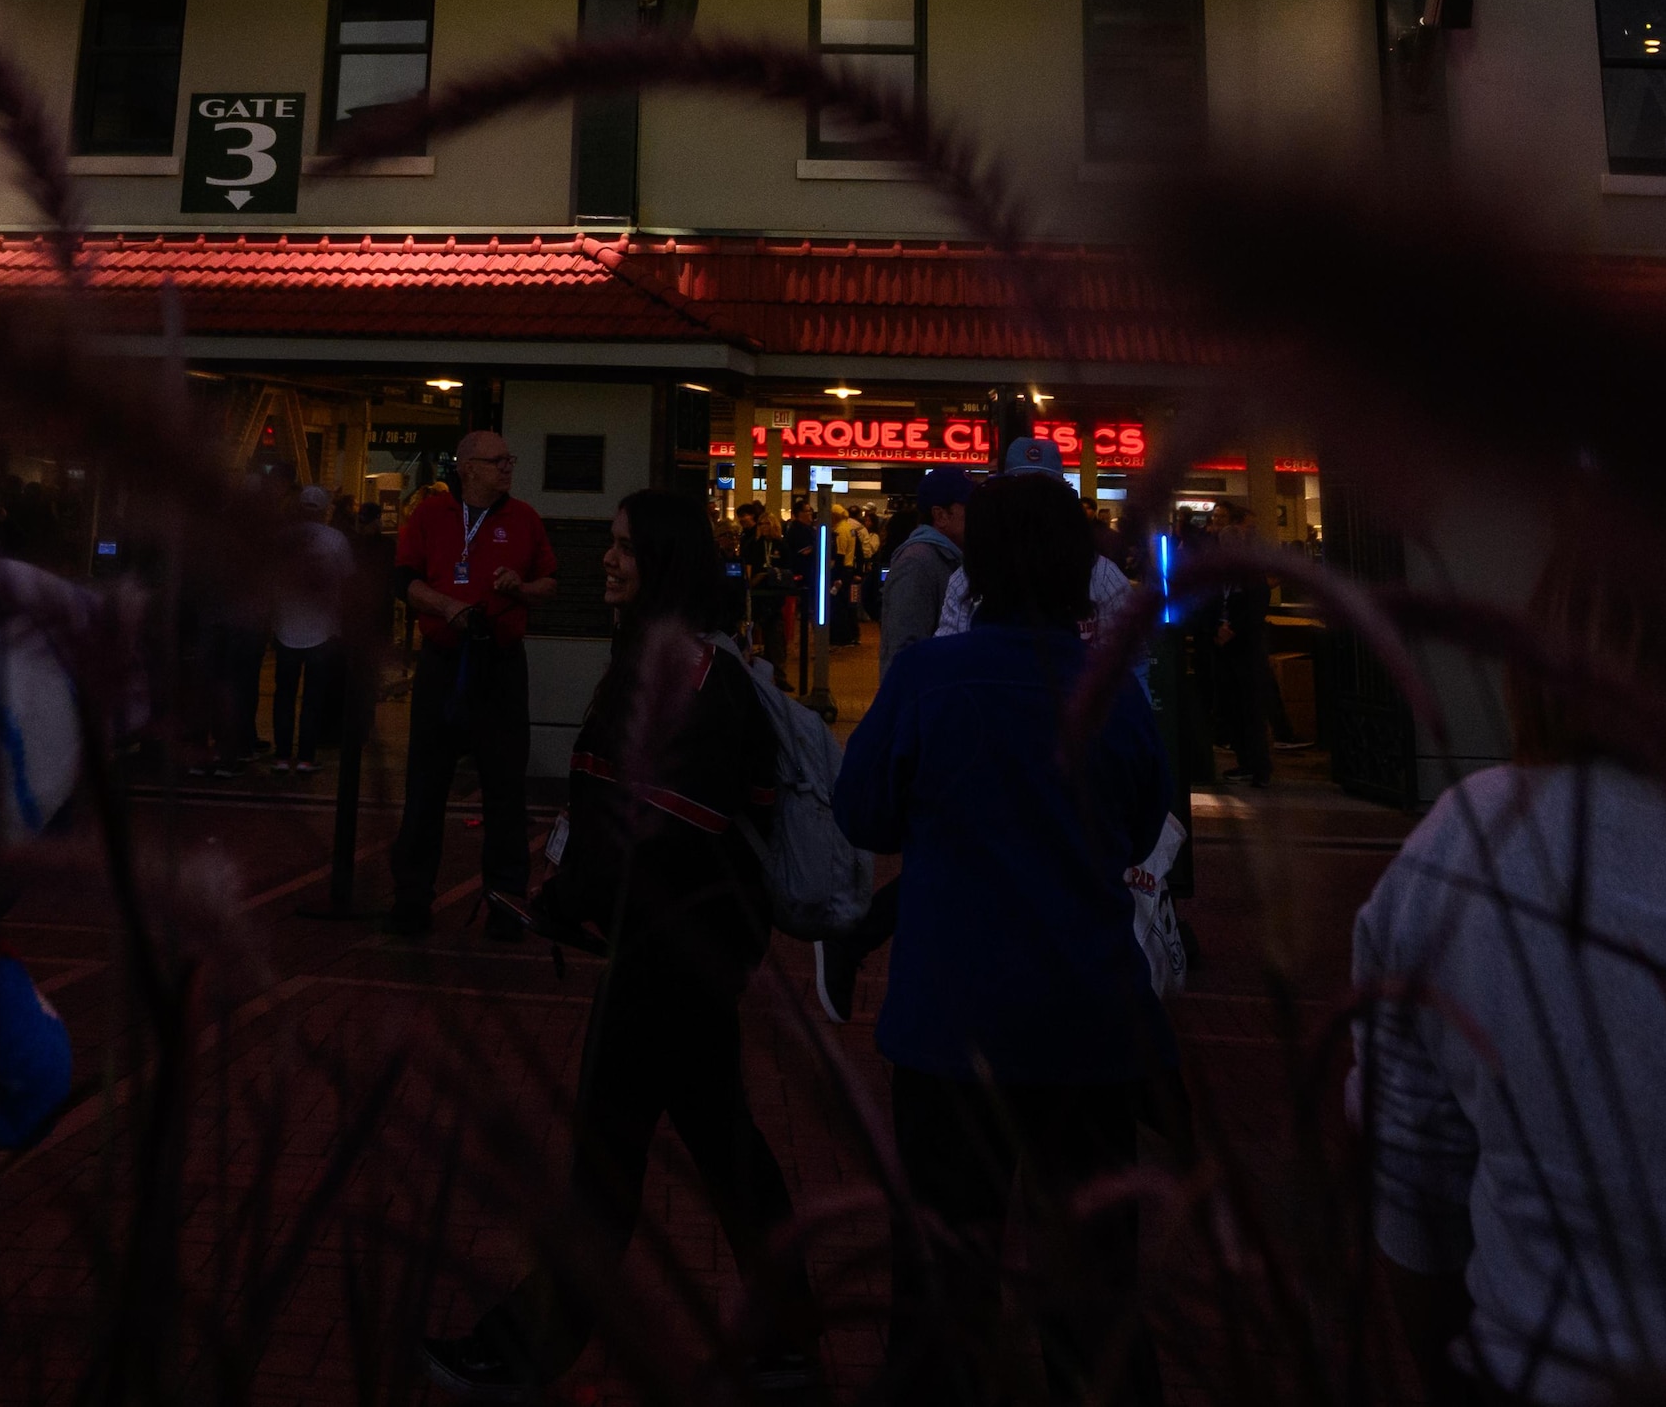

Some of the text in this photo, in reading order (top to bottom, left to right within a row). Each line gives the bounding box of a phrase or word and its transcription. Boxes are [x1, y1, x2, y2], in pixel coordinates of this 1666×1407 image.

[199, 99, 297, 118] GATE
[205, 121, 277, 187] 3
[773, 410, 791, 424] EXIT
[837, 447, 912, 460] SIGNATURE
